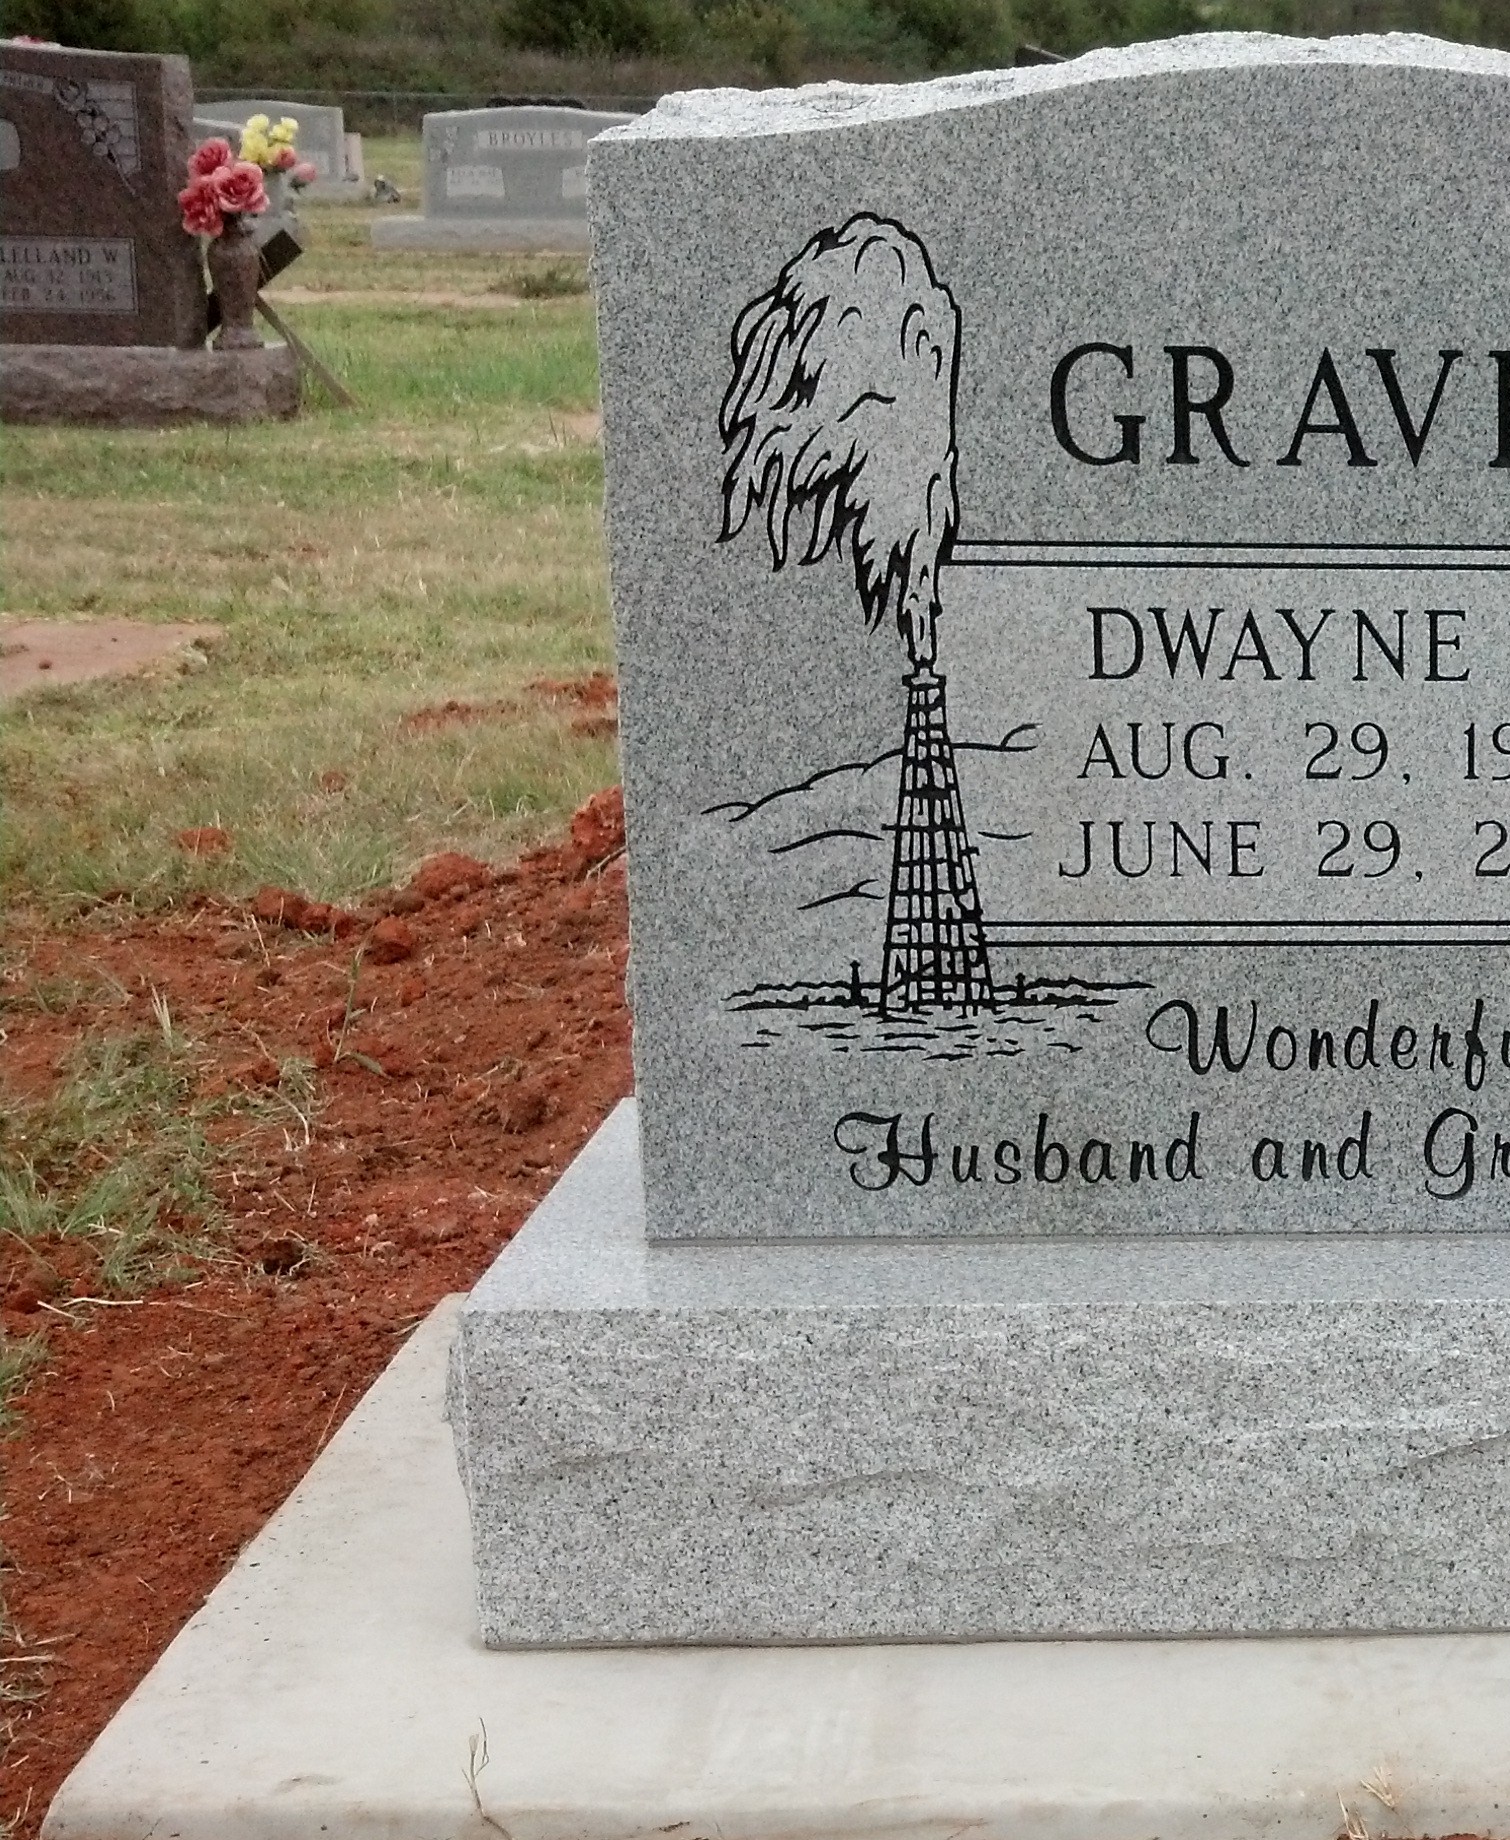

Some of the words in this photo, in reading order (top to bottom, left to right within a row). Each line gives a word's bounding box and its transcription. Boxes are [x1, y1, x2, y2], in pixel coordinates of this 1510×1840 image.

[488, 131, 573, 147] BROYLES
[1087, 606, 1471, 682] DWAYNE
[1077, 722, 1254, 781] AUG.
[1305, 722, 1412, 785] 29,
[1058, 820, 1266, 879] JUNE
[1317, 820, 1424, 883] 29,
[833, 1111, 1203, 1190] Husband
[1251, 1111, 1372, 1181] and
